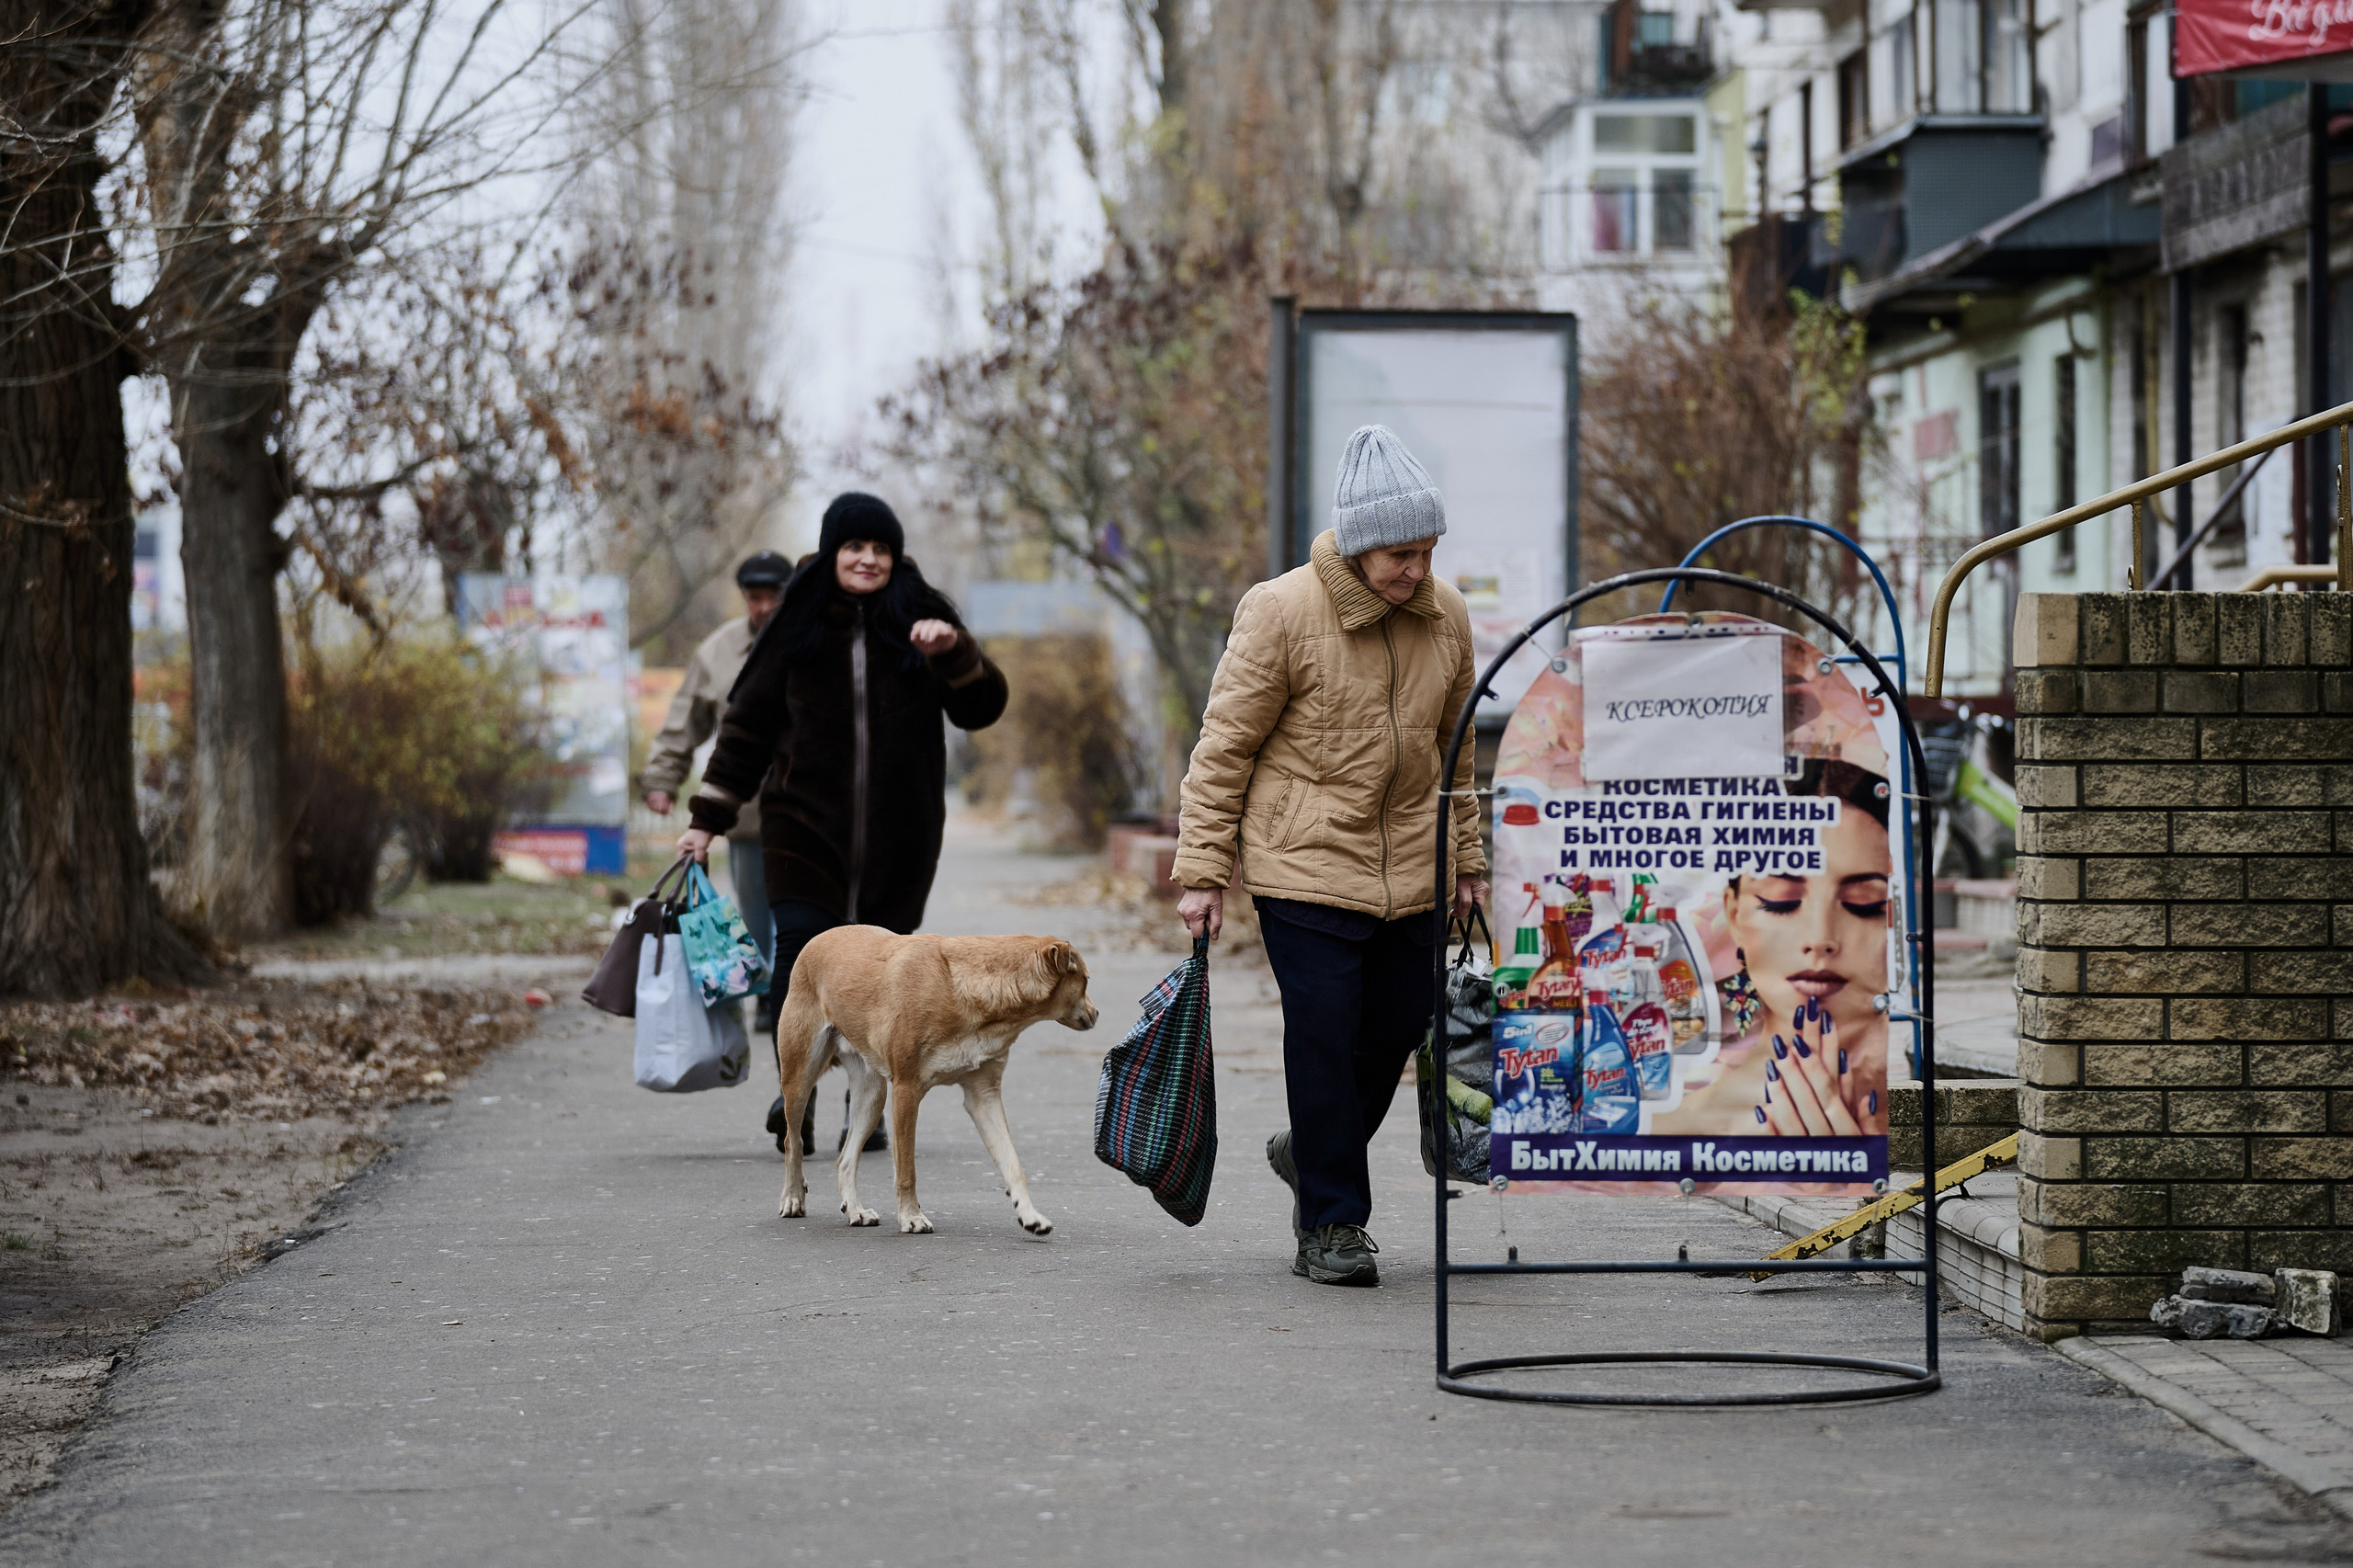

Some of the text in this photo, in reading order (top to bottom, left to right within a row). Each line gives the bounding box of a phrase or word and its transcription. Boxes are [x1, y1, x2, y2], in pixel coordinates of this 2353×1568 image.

[1606, 694, 1774, 722] КСЕРОКОПИЯ
[1603, 778, 1780, 796] КОСМЕТИКА
[1544, 801, 1835, 824] СРЕДСТВА ГИГИЕНЫ
[1563, 826, 1814, 846] БЫТОВАЯ ХИМИЯ
[1561, 849, 1821, 873] И МНОГОЕ ДРУГОЕ
[1583, 946, 1627, 970] Tytan
[1536, 980, 1575, 1003] Tytan
[1499, 1046, 1559, 1079] Tytan
[1583, 1068, 1625, 1091] Tytan
[1511, 1140, 1869, 1172] БытХимия Косметика
